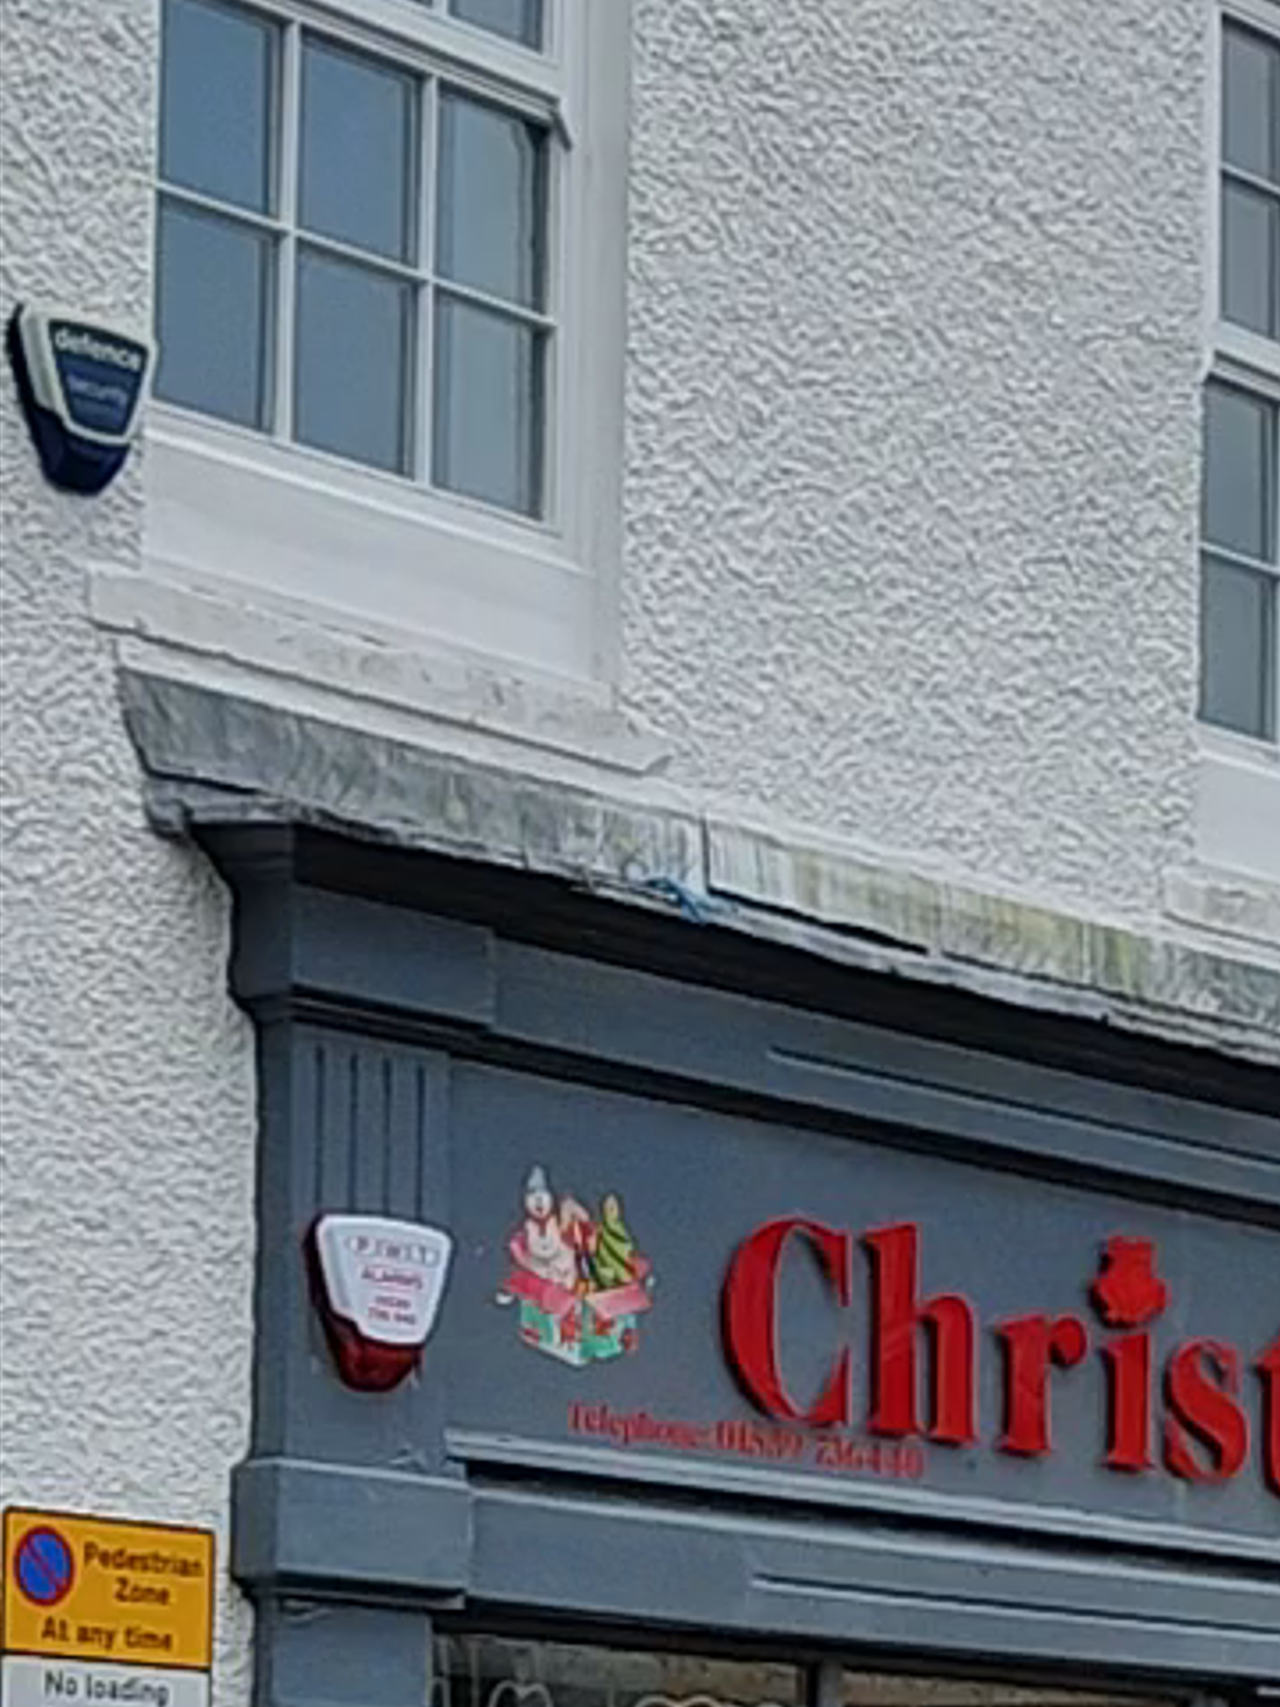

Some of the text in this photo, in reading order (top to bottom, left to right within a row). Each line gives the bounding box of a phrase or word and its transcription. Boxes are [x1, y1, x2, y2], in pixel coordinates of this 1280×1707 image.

[84, 1542, 204, 1577] Pedestrian
[115, 1577, 170, 1605] Zone
[42, 1616, 173, 1651] At any time
[45, 1671, 77, 1696] No
